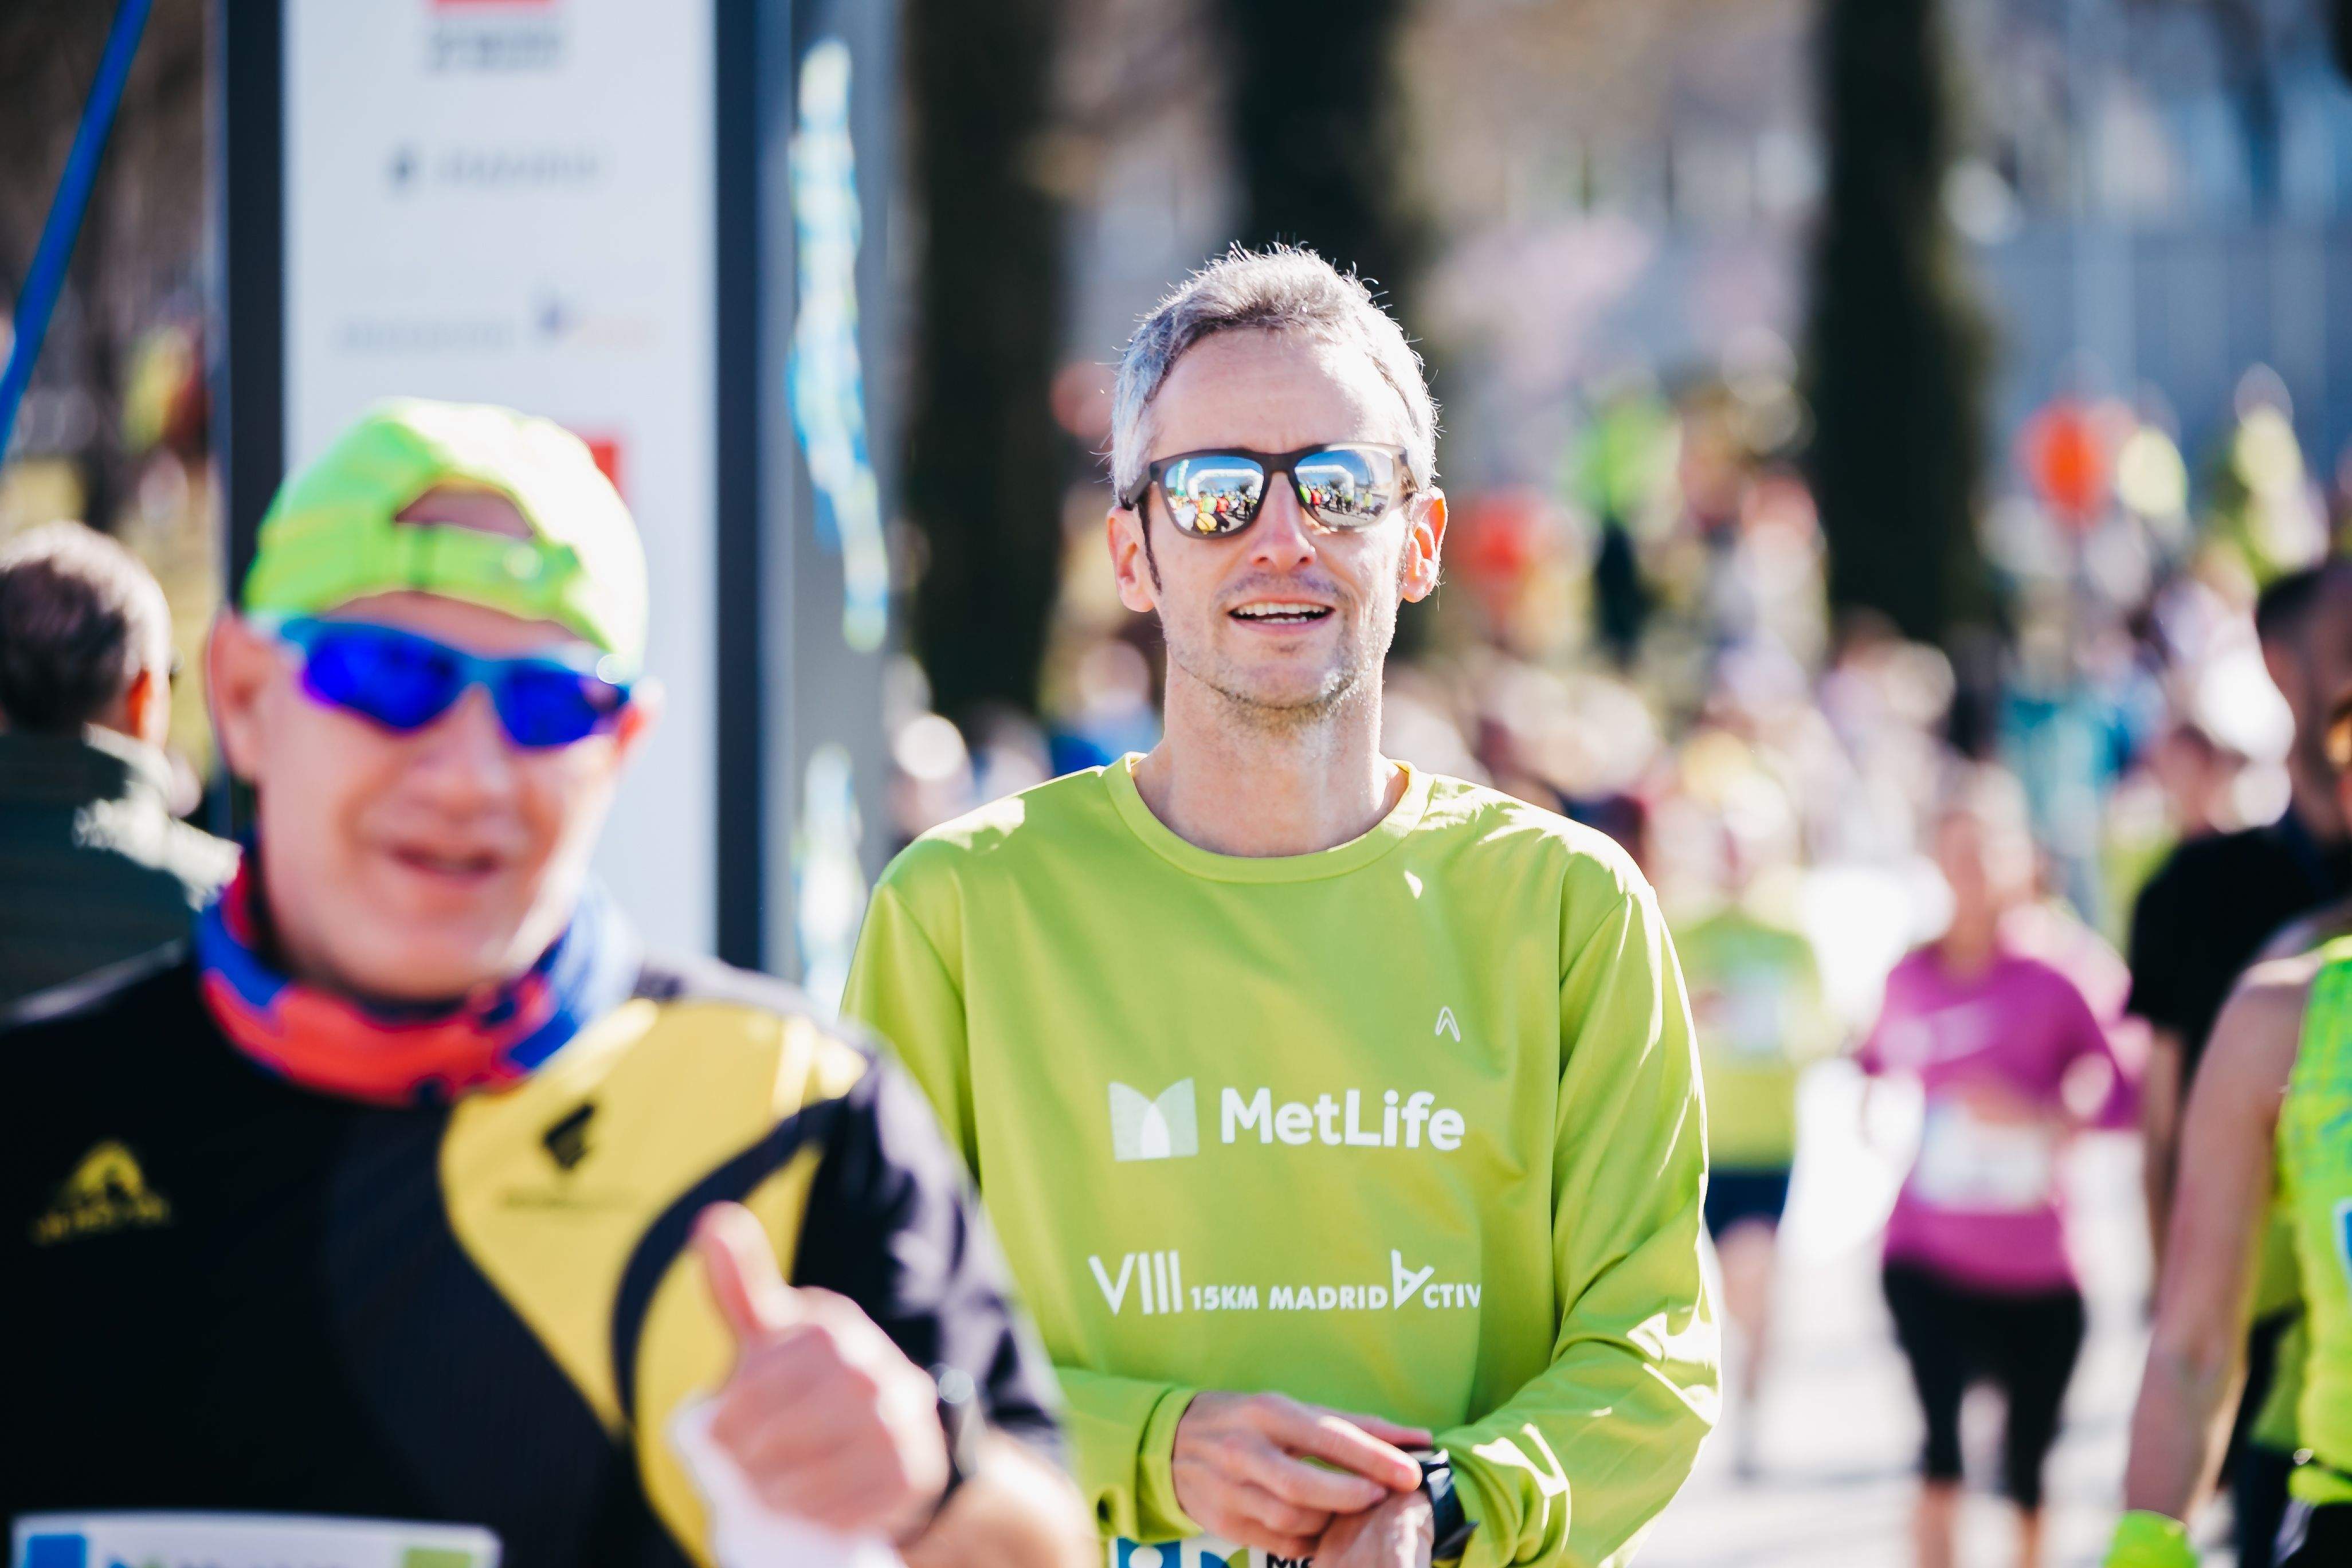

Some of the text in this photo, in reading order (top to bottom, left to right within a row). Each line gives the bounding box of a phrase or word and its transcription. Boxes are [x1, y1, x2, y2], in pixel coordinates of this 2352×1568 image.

[1221, 1087, 1465, 1151] MetLife
[1088, 1249, 1183, 1315] VIII
[1190, 1285, 1259, 1311] 15KM
[1268, 1284, 1388, 1311] MADRID
